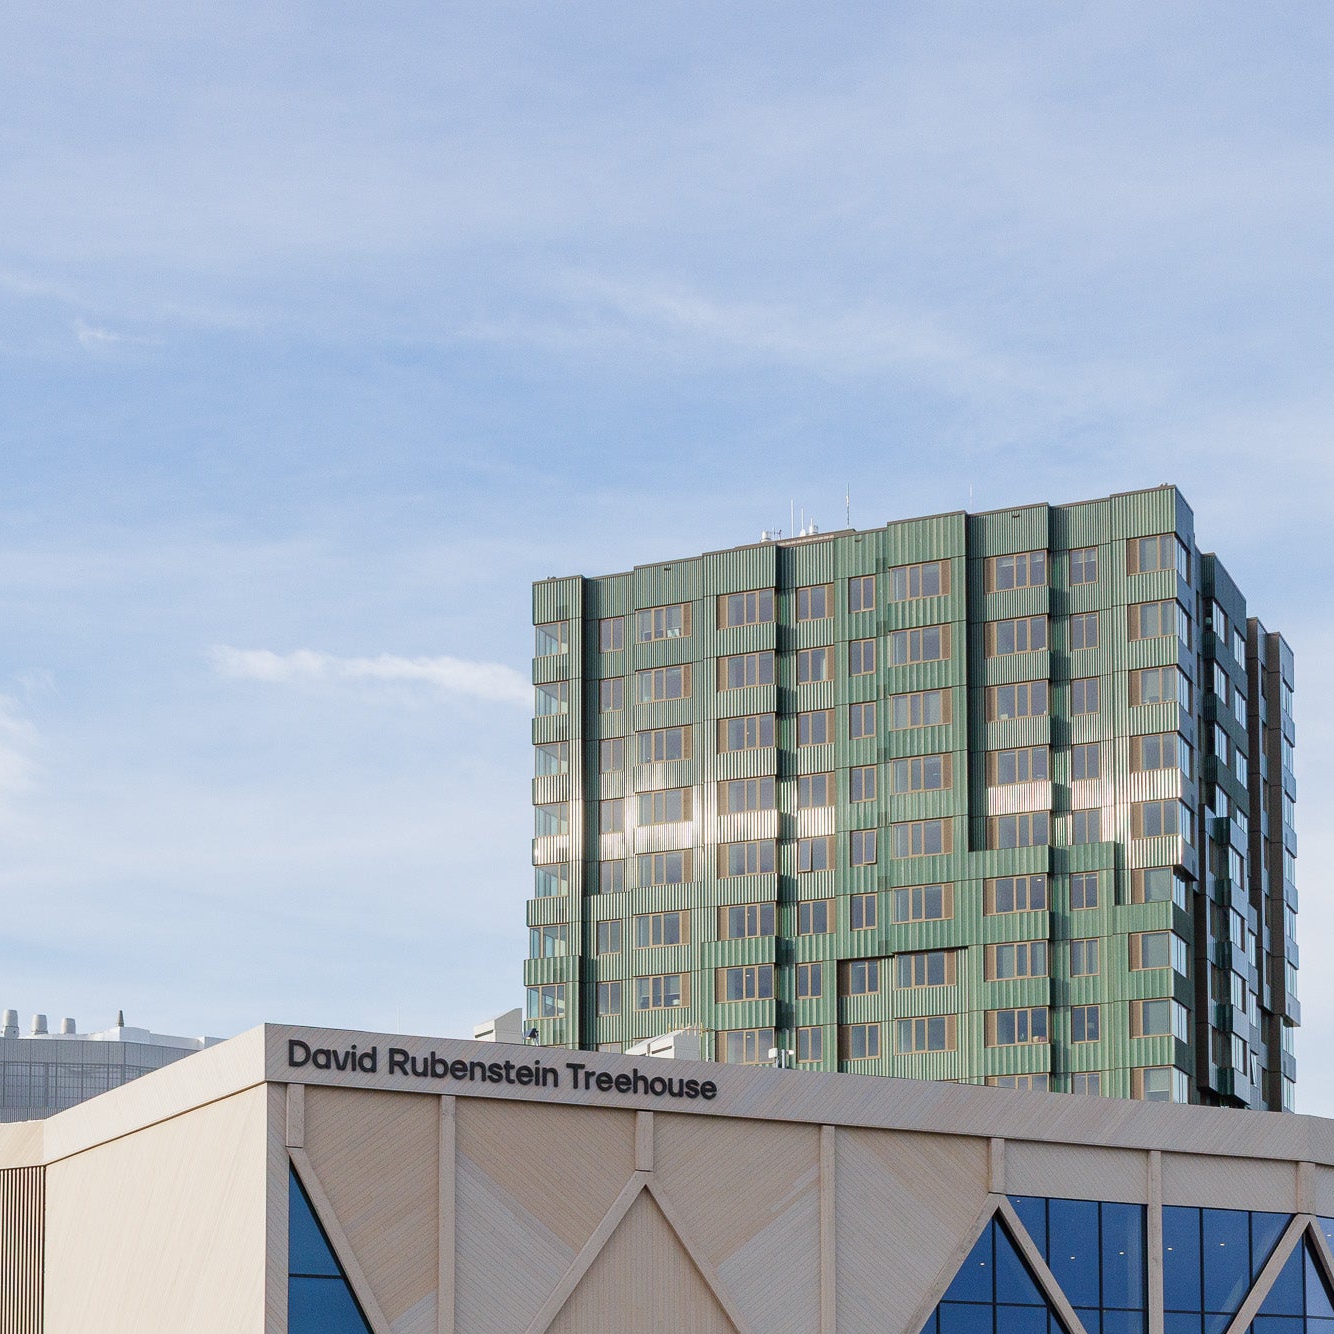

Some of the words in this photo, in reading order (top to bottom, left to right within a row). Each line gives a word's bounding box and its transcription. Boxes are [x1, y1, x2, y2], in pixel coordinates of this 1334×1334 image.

[288, 1039, 377, 1074] David
[388, 1047, 559, 1088] Rubenstein
[566, 1062, 718, 1100] Treehouse
